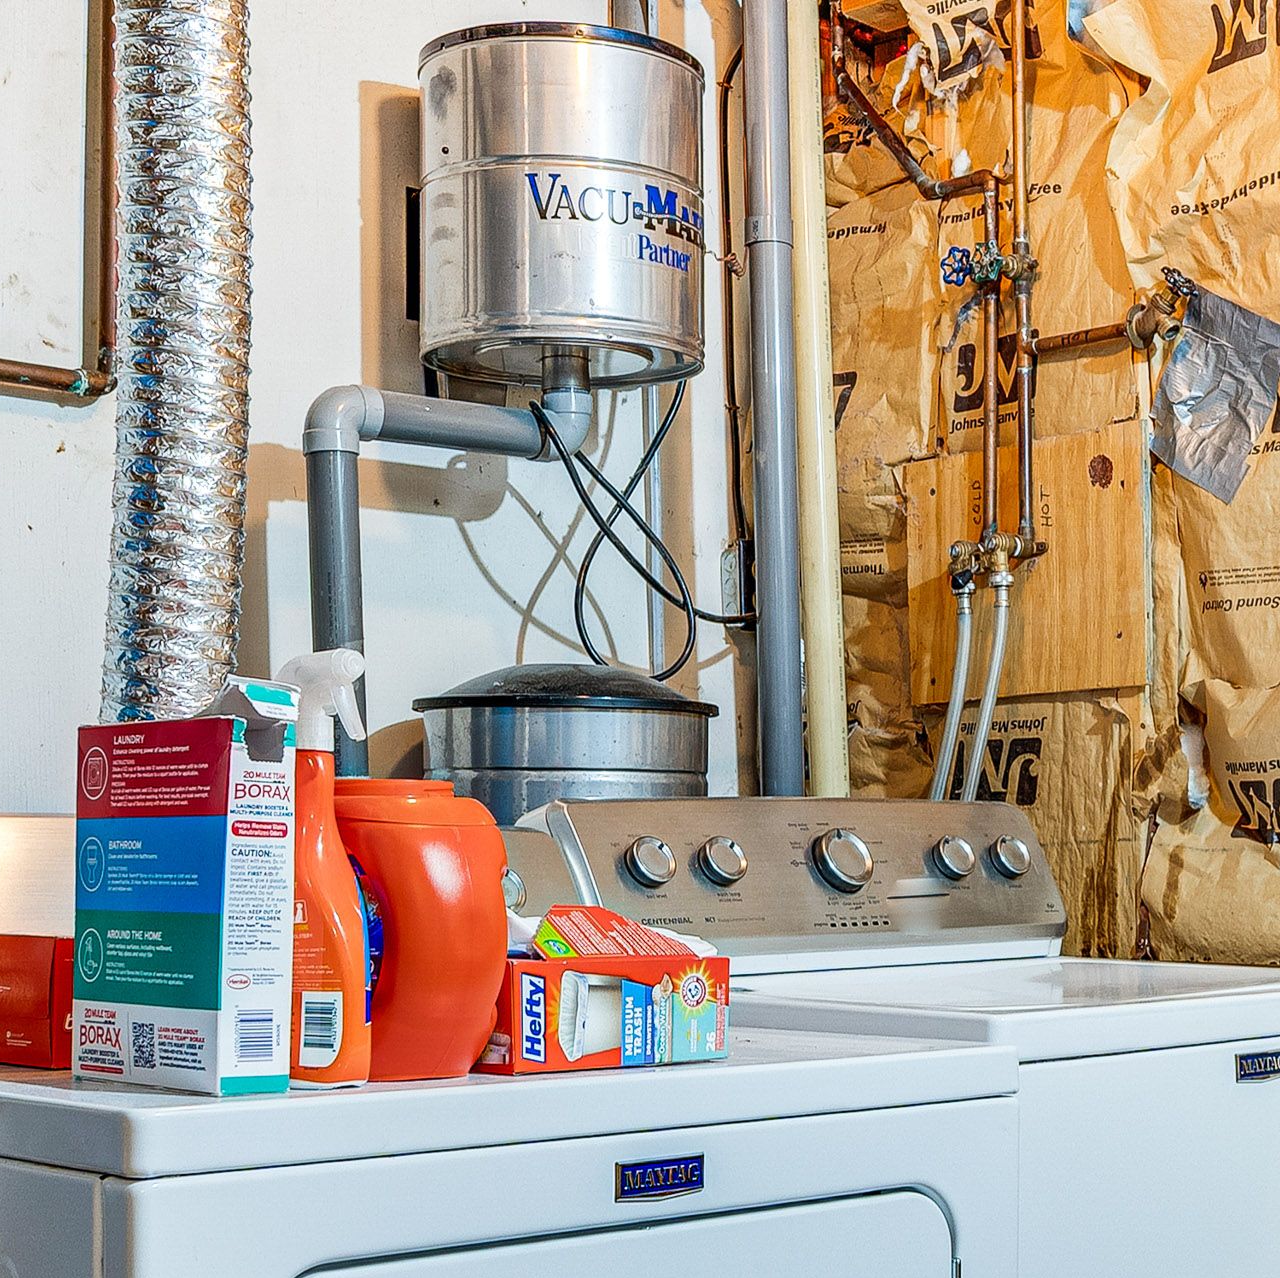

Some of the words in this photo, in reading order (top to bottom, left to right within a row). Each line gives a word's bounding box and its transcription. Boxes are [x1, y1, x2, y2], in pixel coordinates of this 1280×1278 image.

[638, 233, 693, 272] Partner
[1061, 332, 1089, 345] HOT
[971, 480, 982, 524] COLD
[1040, 485, 1052, 526] HOT
[1236, 596, 1280, 610] Sound
[1010, 716, 1047, 731] Johns
[113, 734, 145, 745] LAUNDRY
[1225, 759, 1267, 775] Manville
[234, 783, 291, 803] BORAX
[108, 840, 142, 850] BATHROOM
[231, 848, 272, 858] CAUTION:
[641, 916, 693, 925] CENTENNIAL
[107, 930, 131, 941] AROUND
[131, 930, 143, 941] THE
[144, 931, 163, 941] HOME
[525, 979, 545, 1057] Hefty
[624, 996, 634, 1057] MEDIUM
[79, 1024, 122, 1051] BORAX
[634, 1007, 643, 1057] TRASH
[706, 1031, 716, 1052] 26
[624, 1163, 700, 1190] MAYTAG
